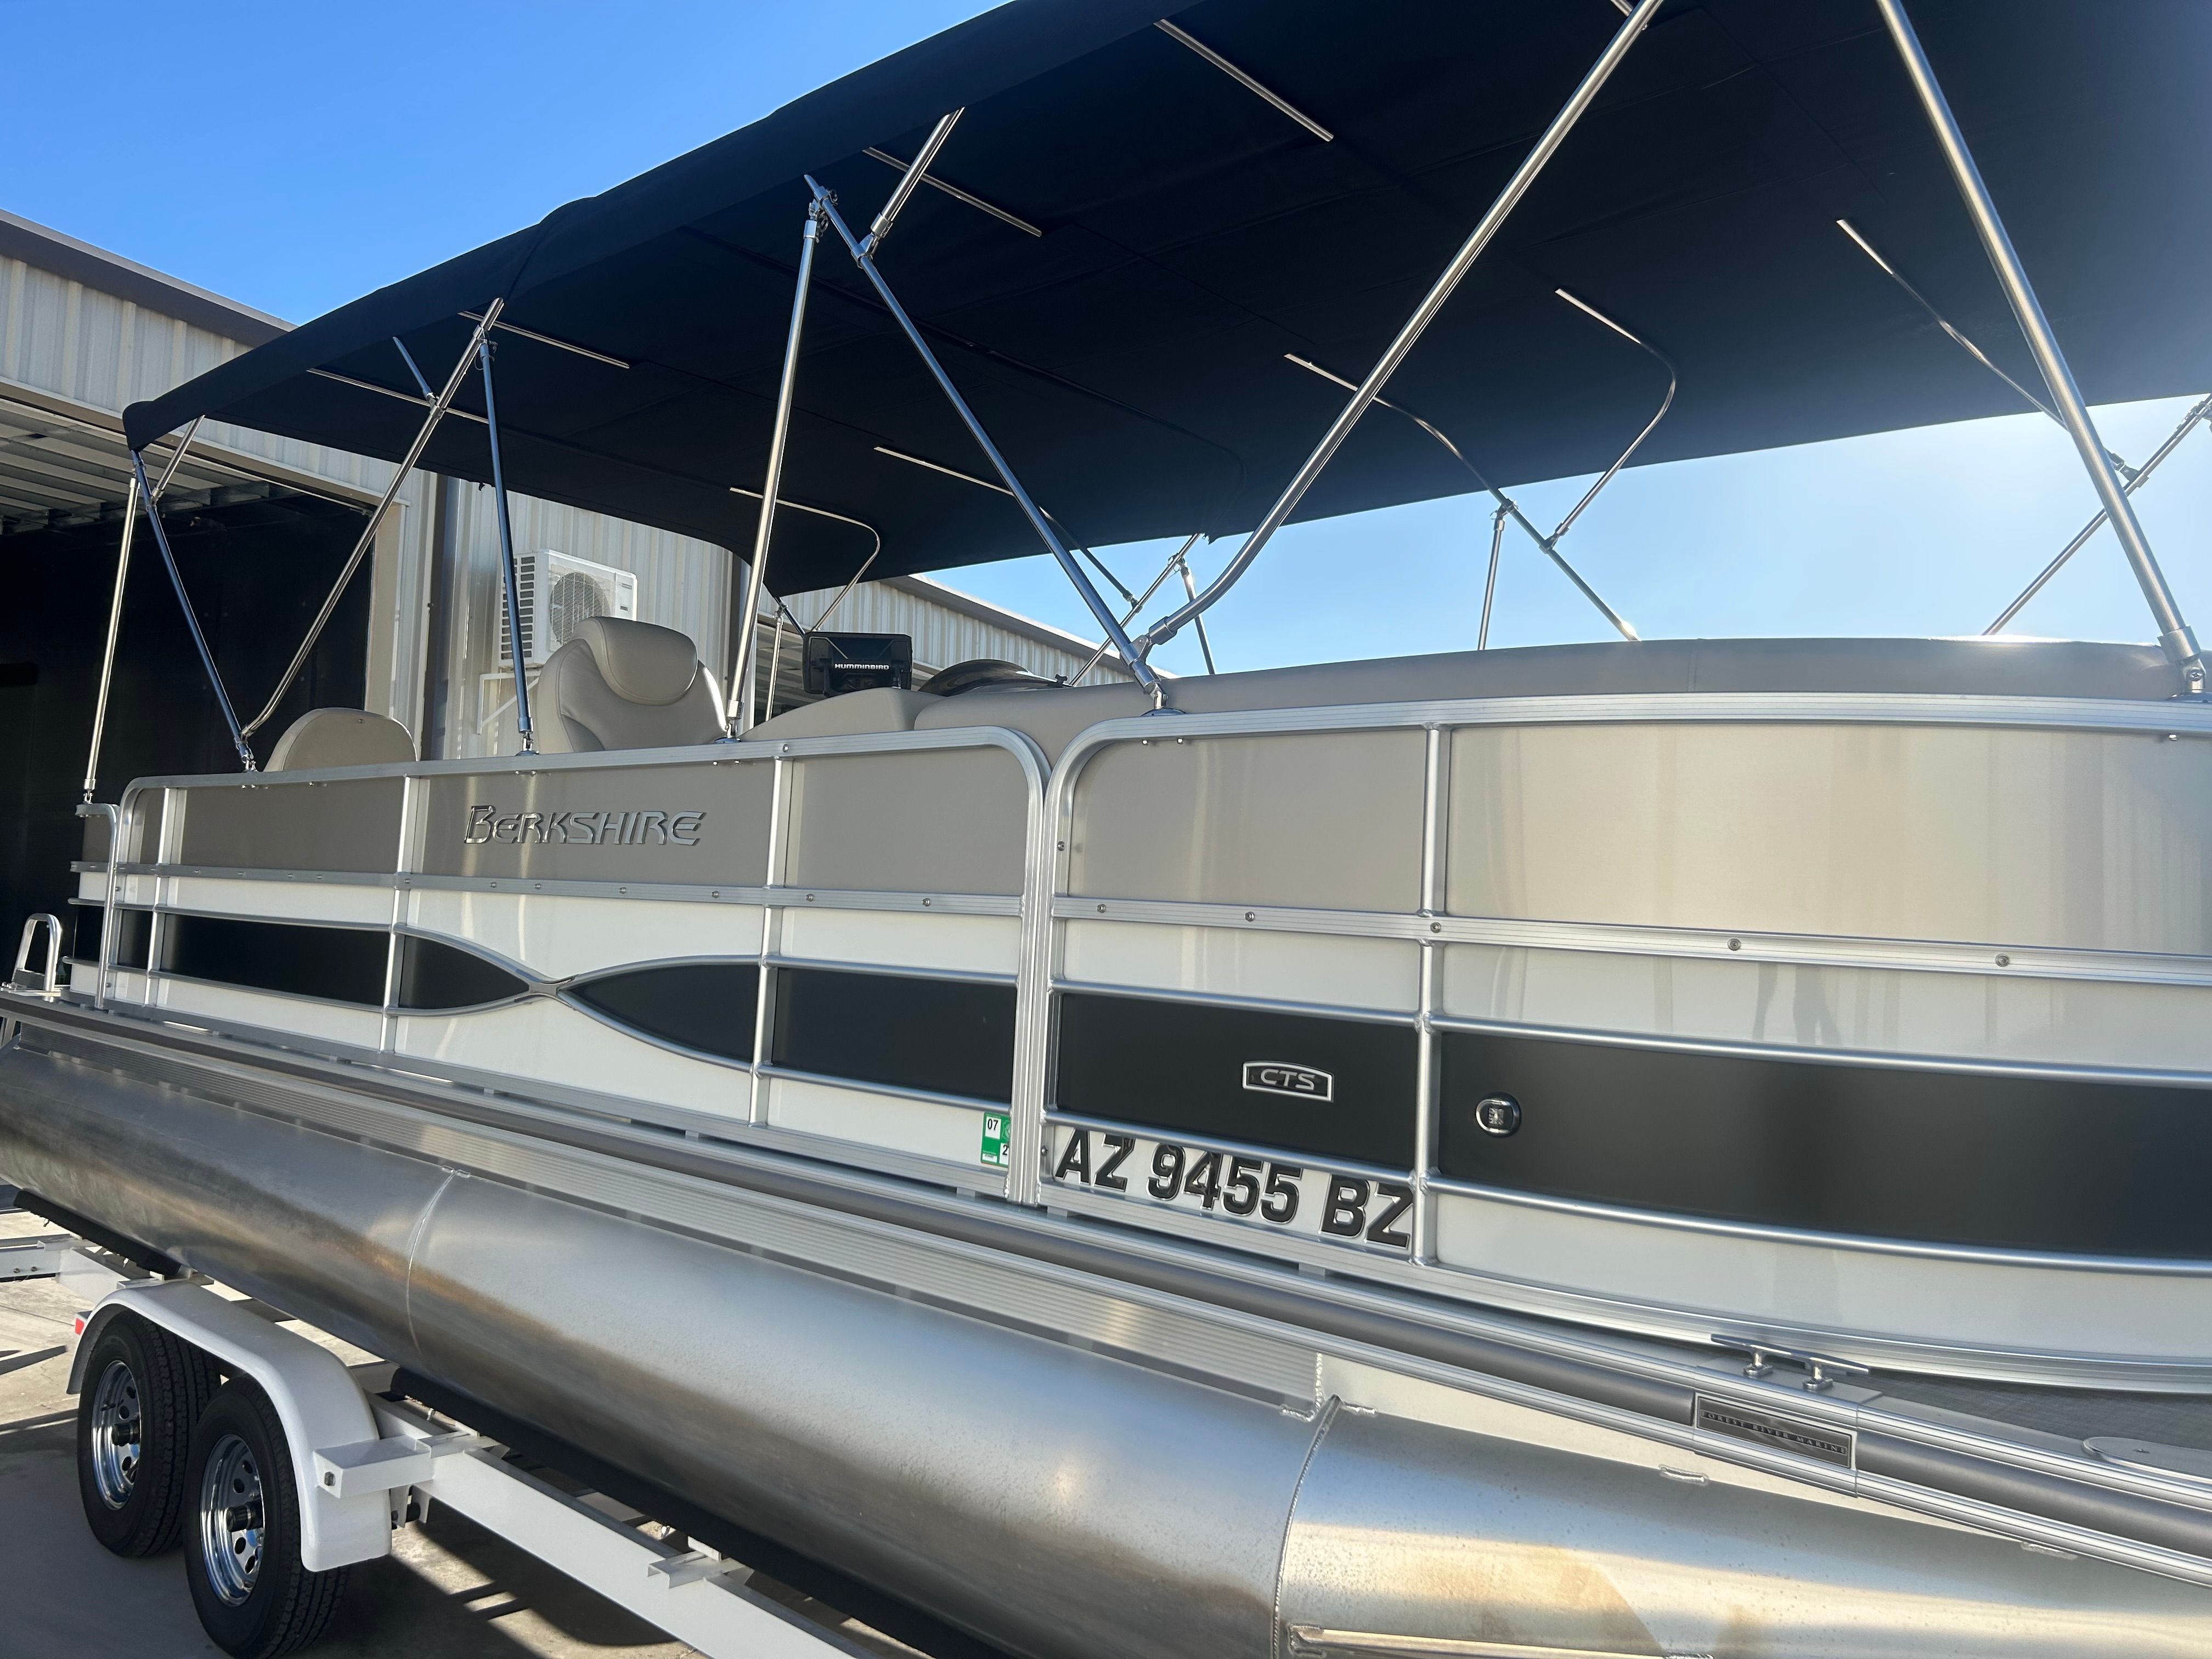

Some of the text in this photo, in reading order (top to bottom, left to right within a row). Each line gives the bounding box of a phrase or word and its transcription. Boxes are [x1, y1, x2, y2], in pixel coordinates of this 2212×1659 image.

[464, 805, 707, 845] BERKSHIRE
[1261, 1068, 1316, 1090] CTS
[988, 1119, 998, 1131] 07
[1054, 1127, 1414, 1248] AZ 9455 BZ
[1701, 1411, 1846, 1453] FOREST RIVER MARINE
